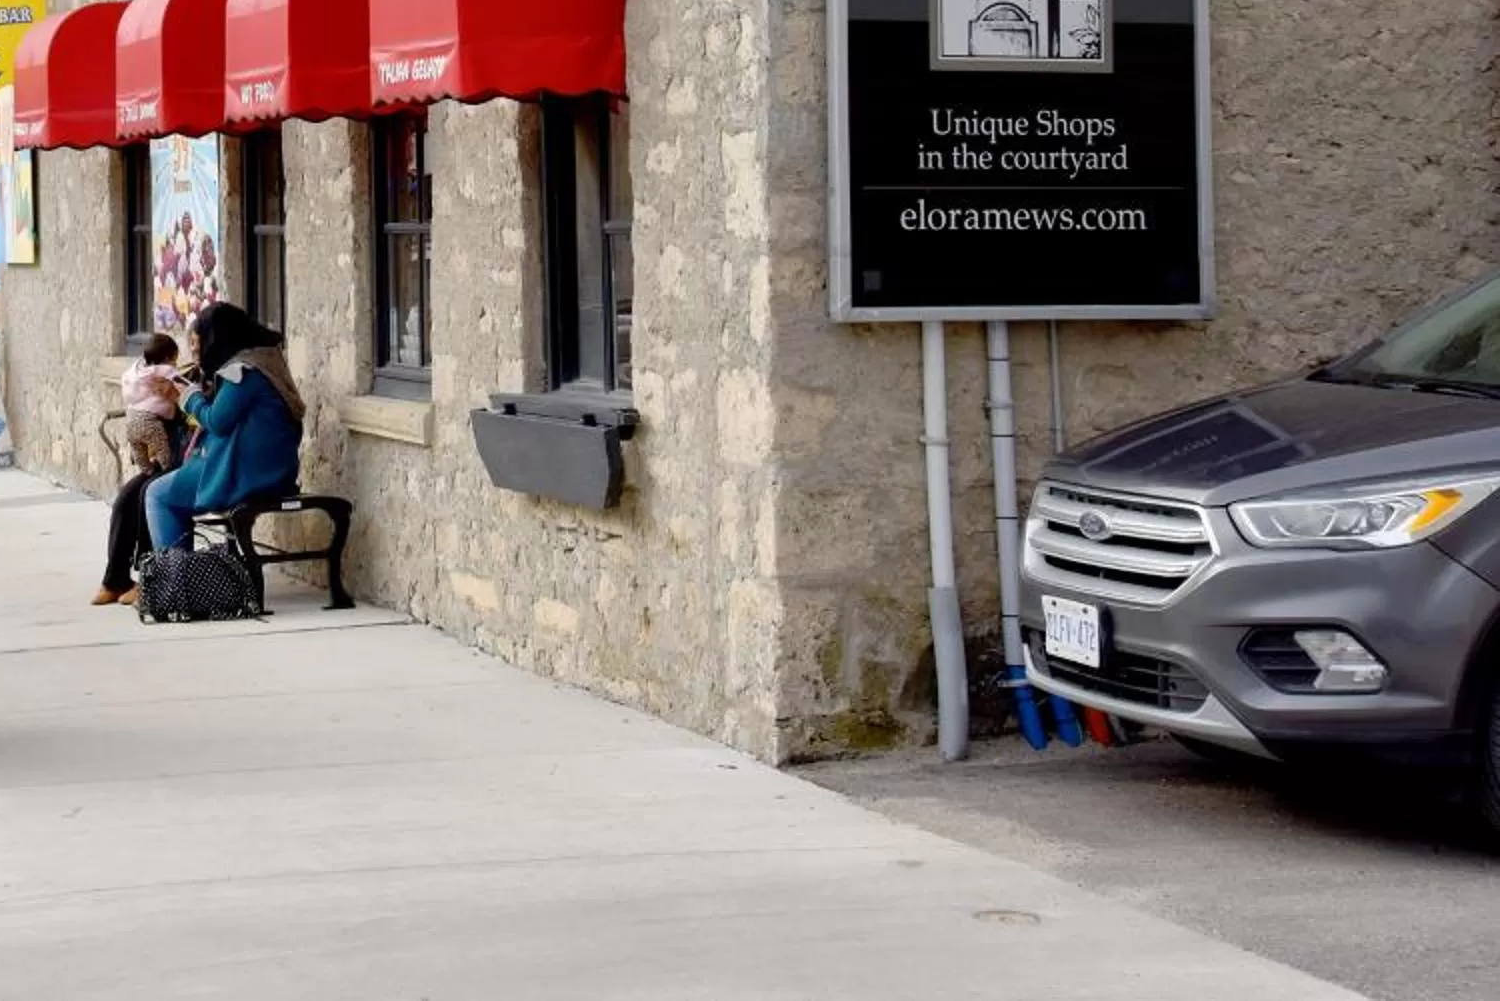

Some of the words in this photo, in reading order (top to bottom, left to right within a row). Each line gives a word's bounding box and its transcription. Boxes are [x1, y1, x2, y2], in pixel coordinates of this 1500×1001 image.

[0, 7, 32, 25] BAR
[930, 108, 1030, 145] Unique
[1035, 109, 1116, 146] Shops
[917, 143, 944, 170] in
[951, 142, 993, 170] the
[1000, 144, 1129, 180] courtyard
[900, 198, 1149, 232] eloramews.com
